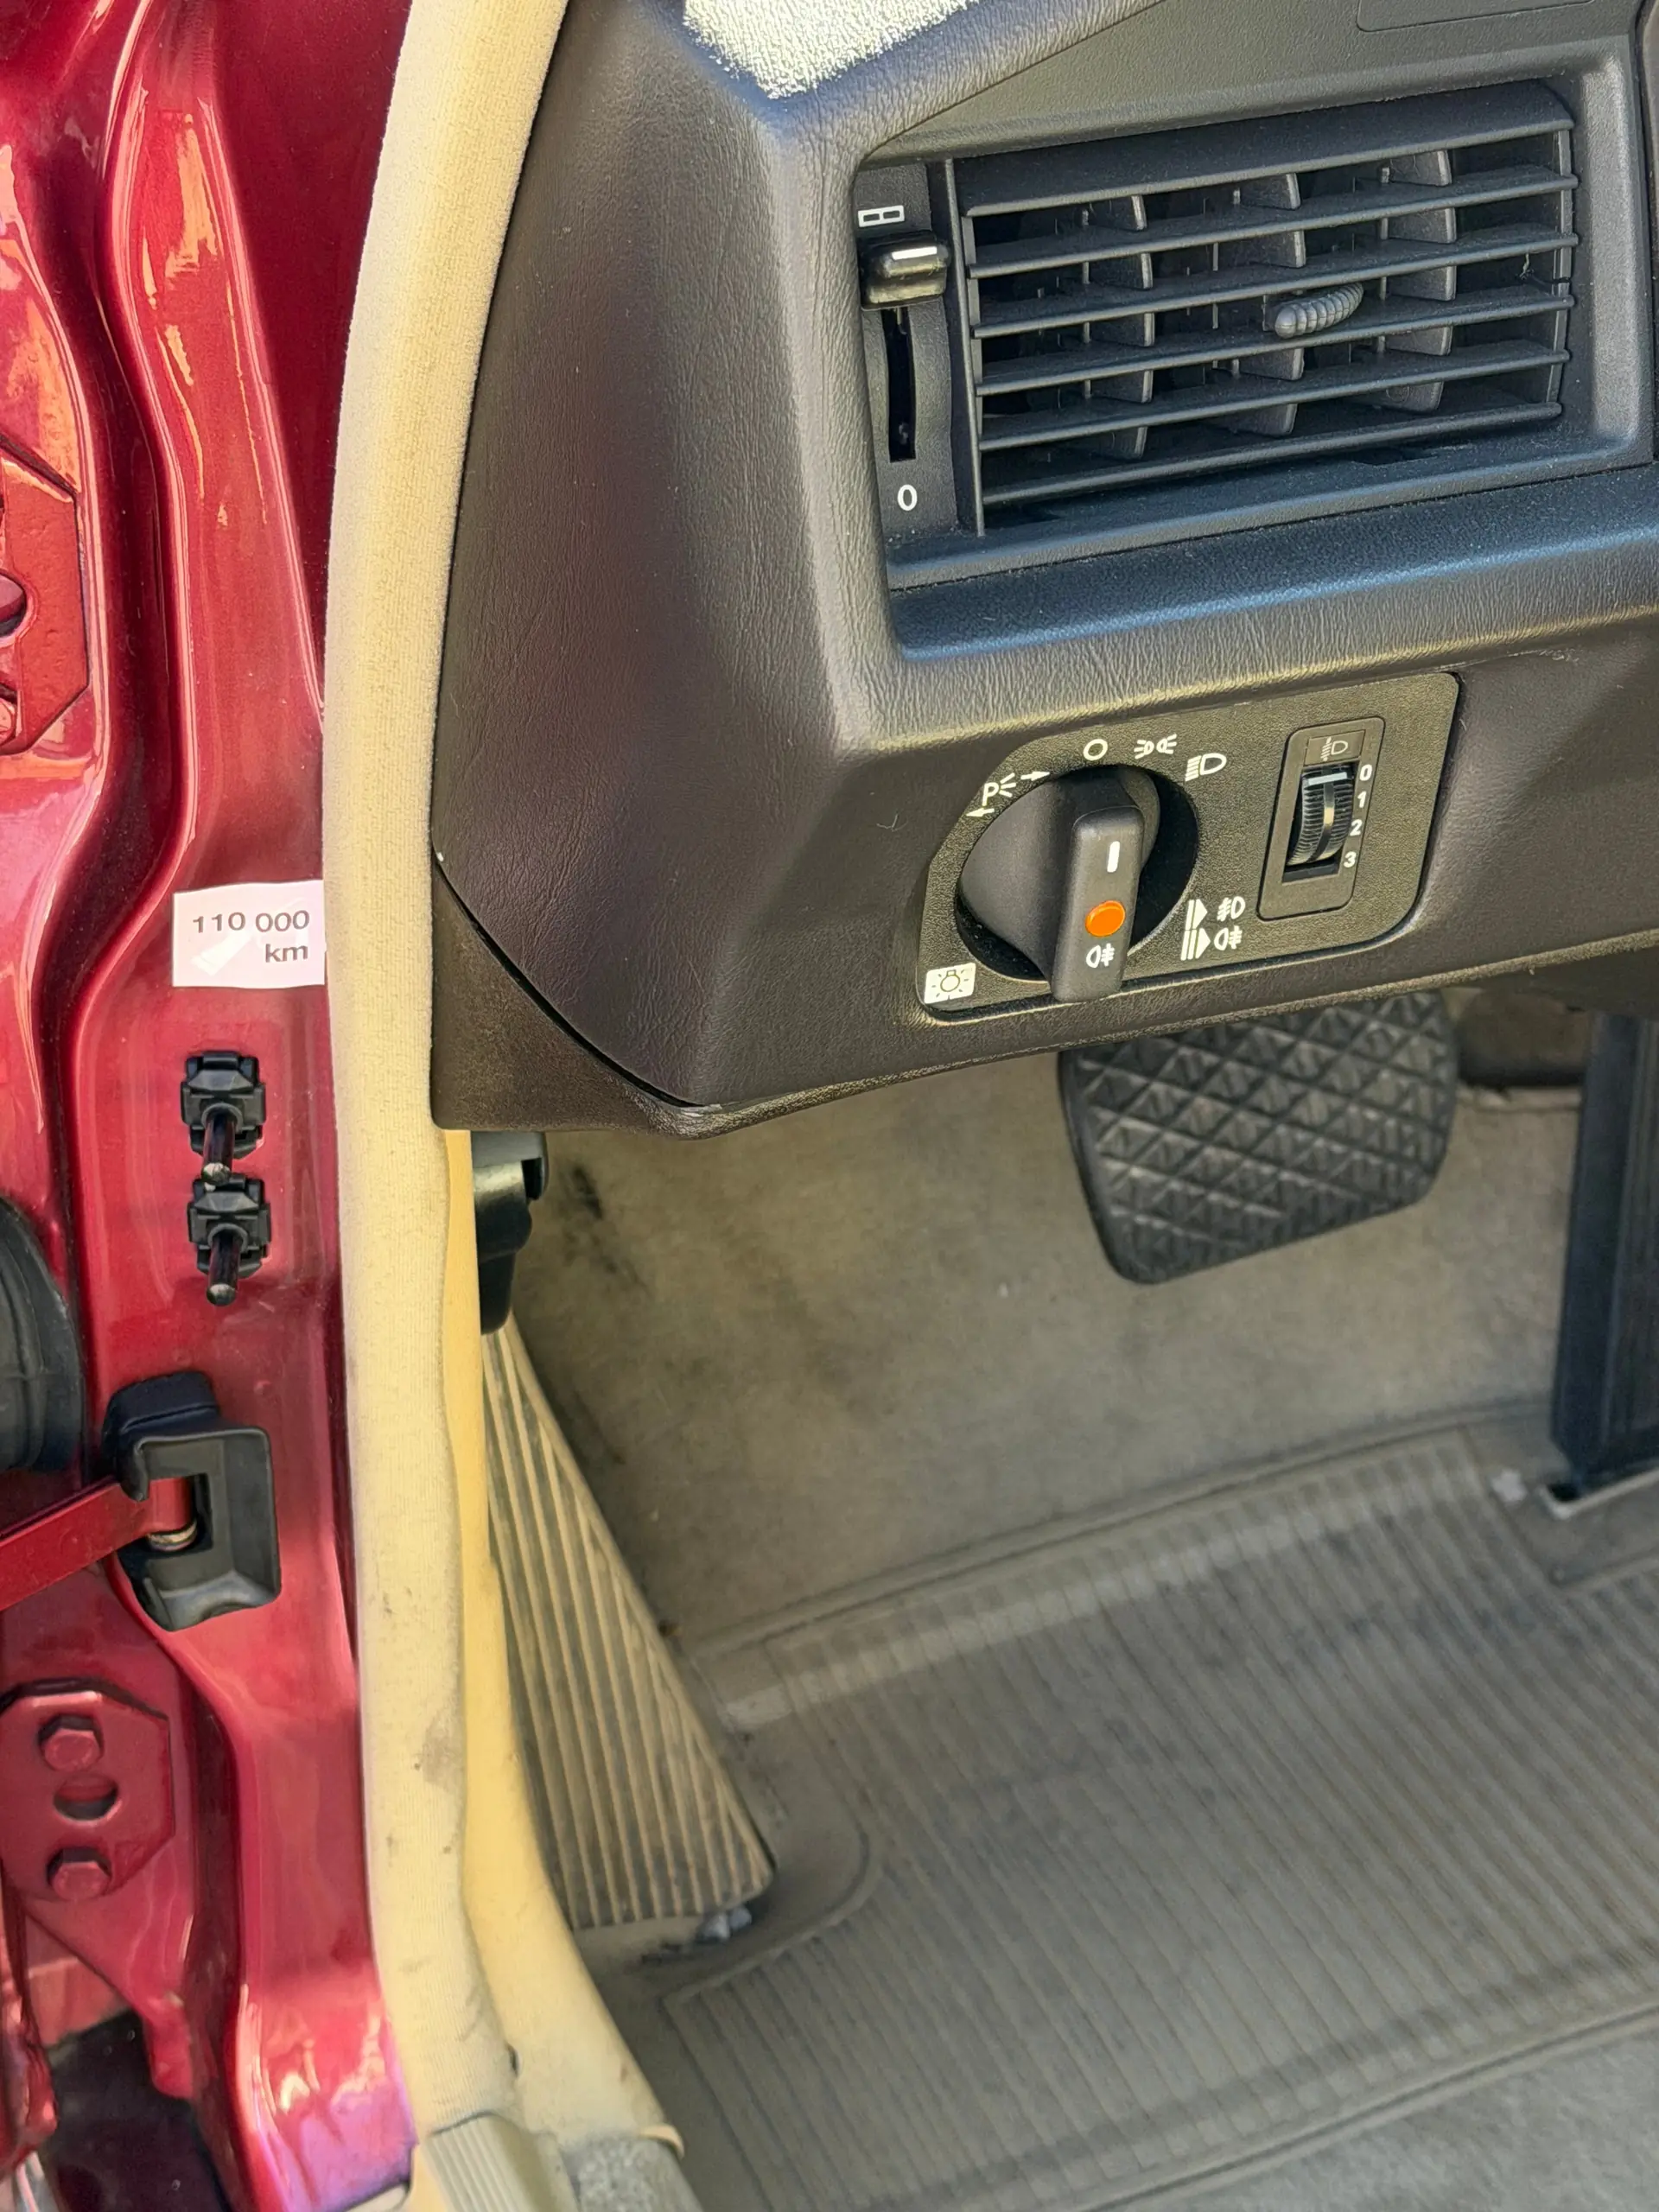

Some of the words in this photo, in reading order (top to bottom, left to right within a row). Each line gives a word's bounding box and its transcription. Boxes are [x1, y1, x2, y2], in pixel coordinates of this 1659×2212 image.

[982, 782, 1000, 806] P
[1357, 791, 1367, 808] 1
[1349, 819, 1363, 836] 2
[1344, 851, 1357, 868] 3
[193, 912, 246, 934] 110
[255, 910, 309, 932] 000
[265, 944, 308, 963] km
